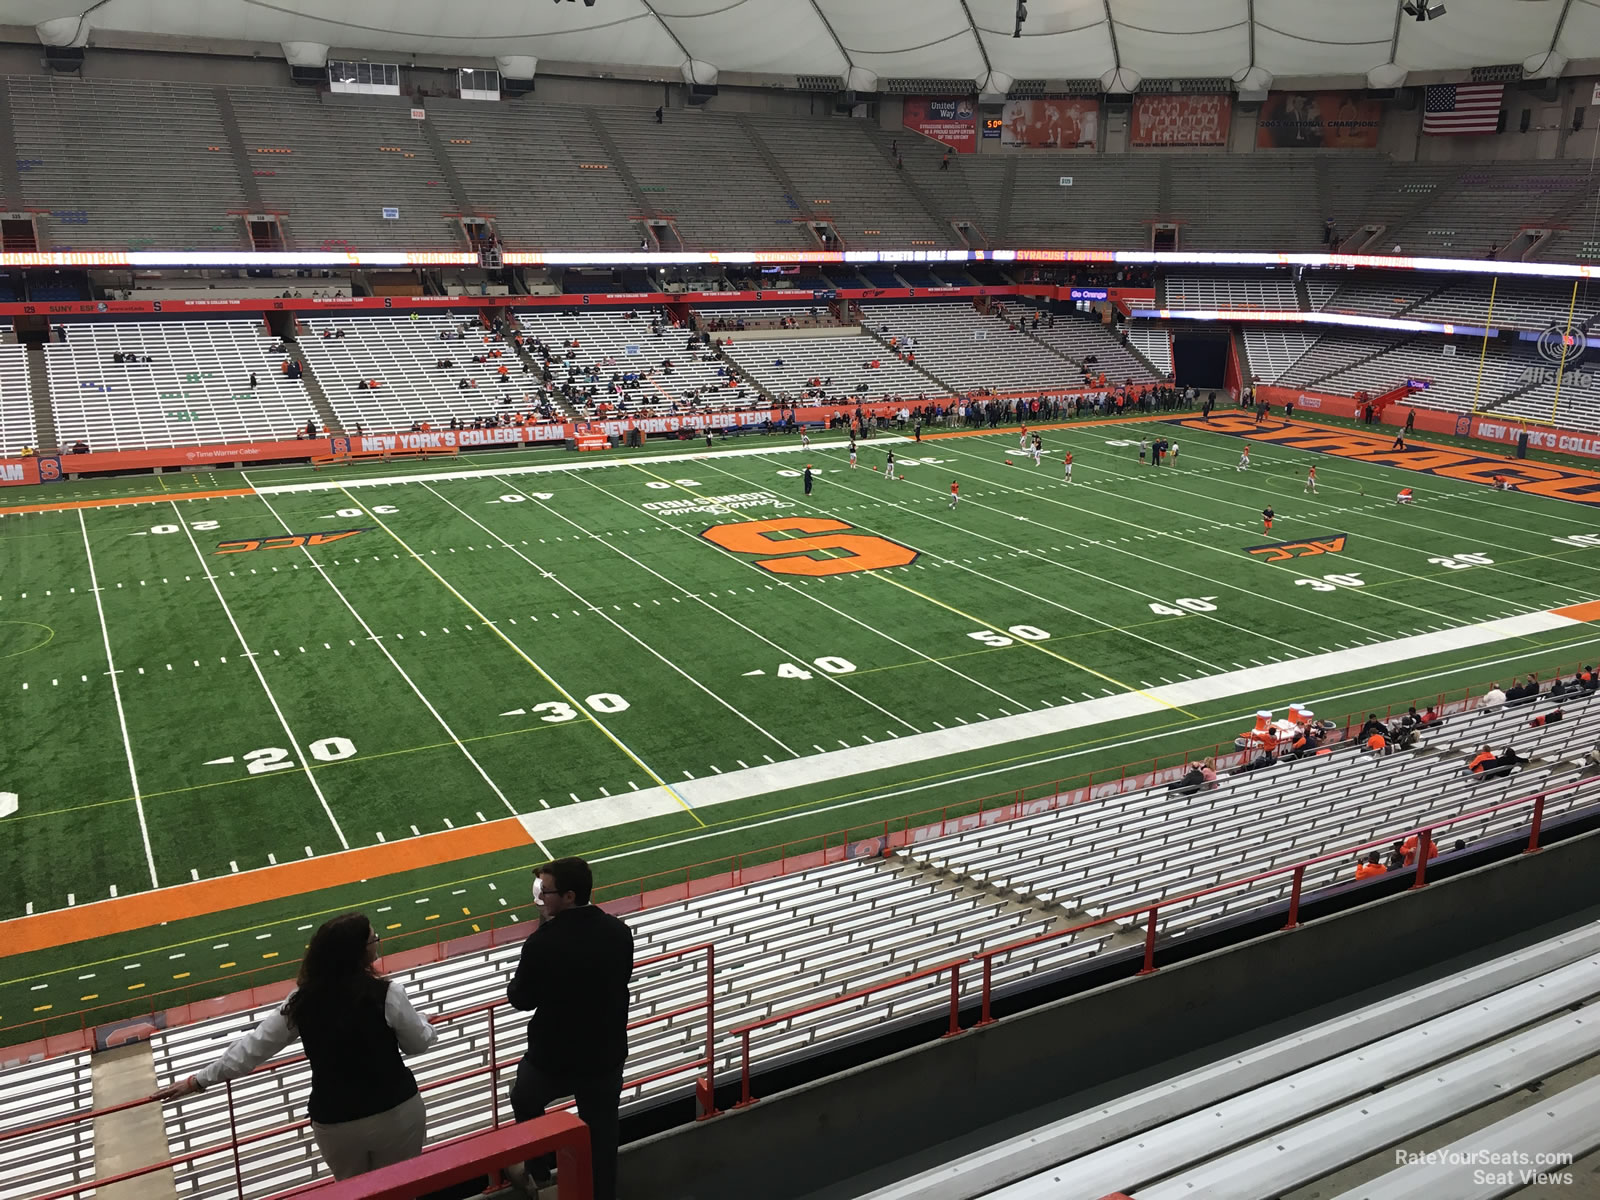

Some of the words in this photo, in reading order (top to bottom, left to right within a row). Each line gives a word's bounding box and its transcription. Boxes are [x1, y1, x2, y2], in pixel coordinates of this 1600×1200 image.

[931, 102, 955, 110] United
[939, 110, 955, 119] Way
[1283, 120, 1325, 128] NATIONAL
[1328, 120, 1379, 128] CHAMPIONS
[61, 252, 129, 265] FOOTBALL
[407, 252, 464, 264] SYRACUSE
[755, 251, 801, 262] SYRACUSE
[803, 250, 843, 262] FOOTBALL
[1017, 251, 1066, 261] SYRACUSE
[1068, 251, 1113, 262] FOOTBALL
[1071, 290, 1081, 299] Go
[1083, 290, 1107, 300] Orange
[1519, 367, 1592, 388] Allstate
[631, 416, 680, 435] YORK'S
[682, 413, 736, 431] COLLEGE
[738, 411, 772, 426] TEAM
[361, 435, 396, 452] NEW
[398, 430, 455, 449] YORK'S
[459, 426, 523, 446] COLLEGE
[525, 424, 564, 442] TEAM
[1477, 422, 1508, 440] NEW
[1509, 427, 1556, 448] YRK'S
[213, 449, 239, 457] Warner
[239, 447, 259, 455] Cable
[645, 478, 703, 490] 50
[499, 491, 554, 504] 40
[641, 499, 697, 510] FIELD
[693, 491, 777, 505] LEGENDS
[335, 504, 400, 519] 30
[150, 520, 221, 535] 20
[697, 516, 922, 577] S
[1427, 553, 1494, 570] 20
[1294, 573, 1365, 591] 30
[1148, 597, 1217, 617] 40
[966, 625, 1051, 648] 50
[776, 656, 857, 681] 40
[531, 693, 632, 724] 30
[242, 737, 358, 776] 20
